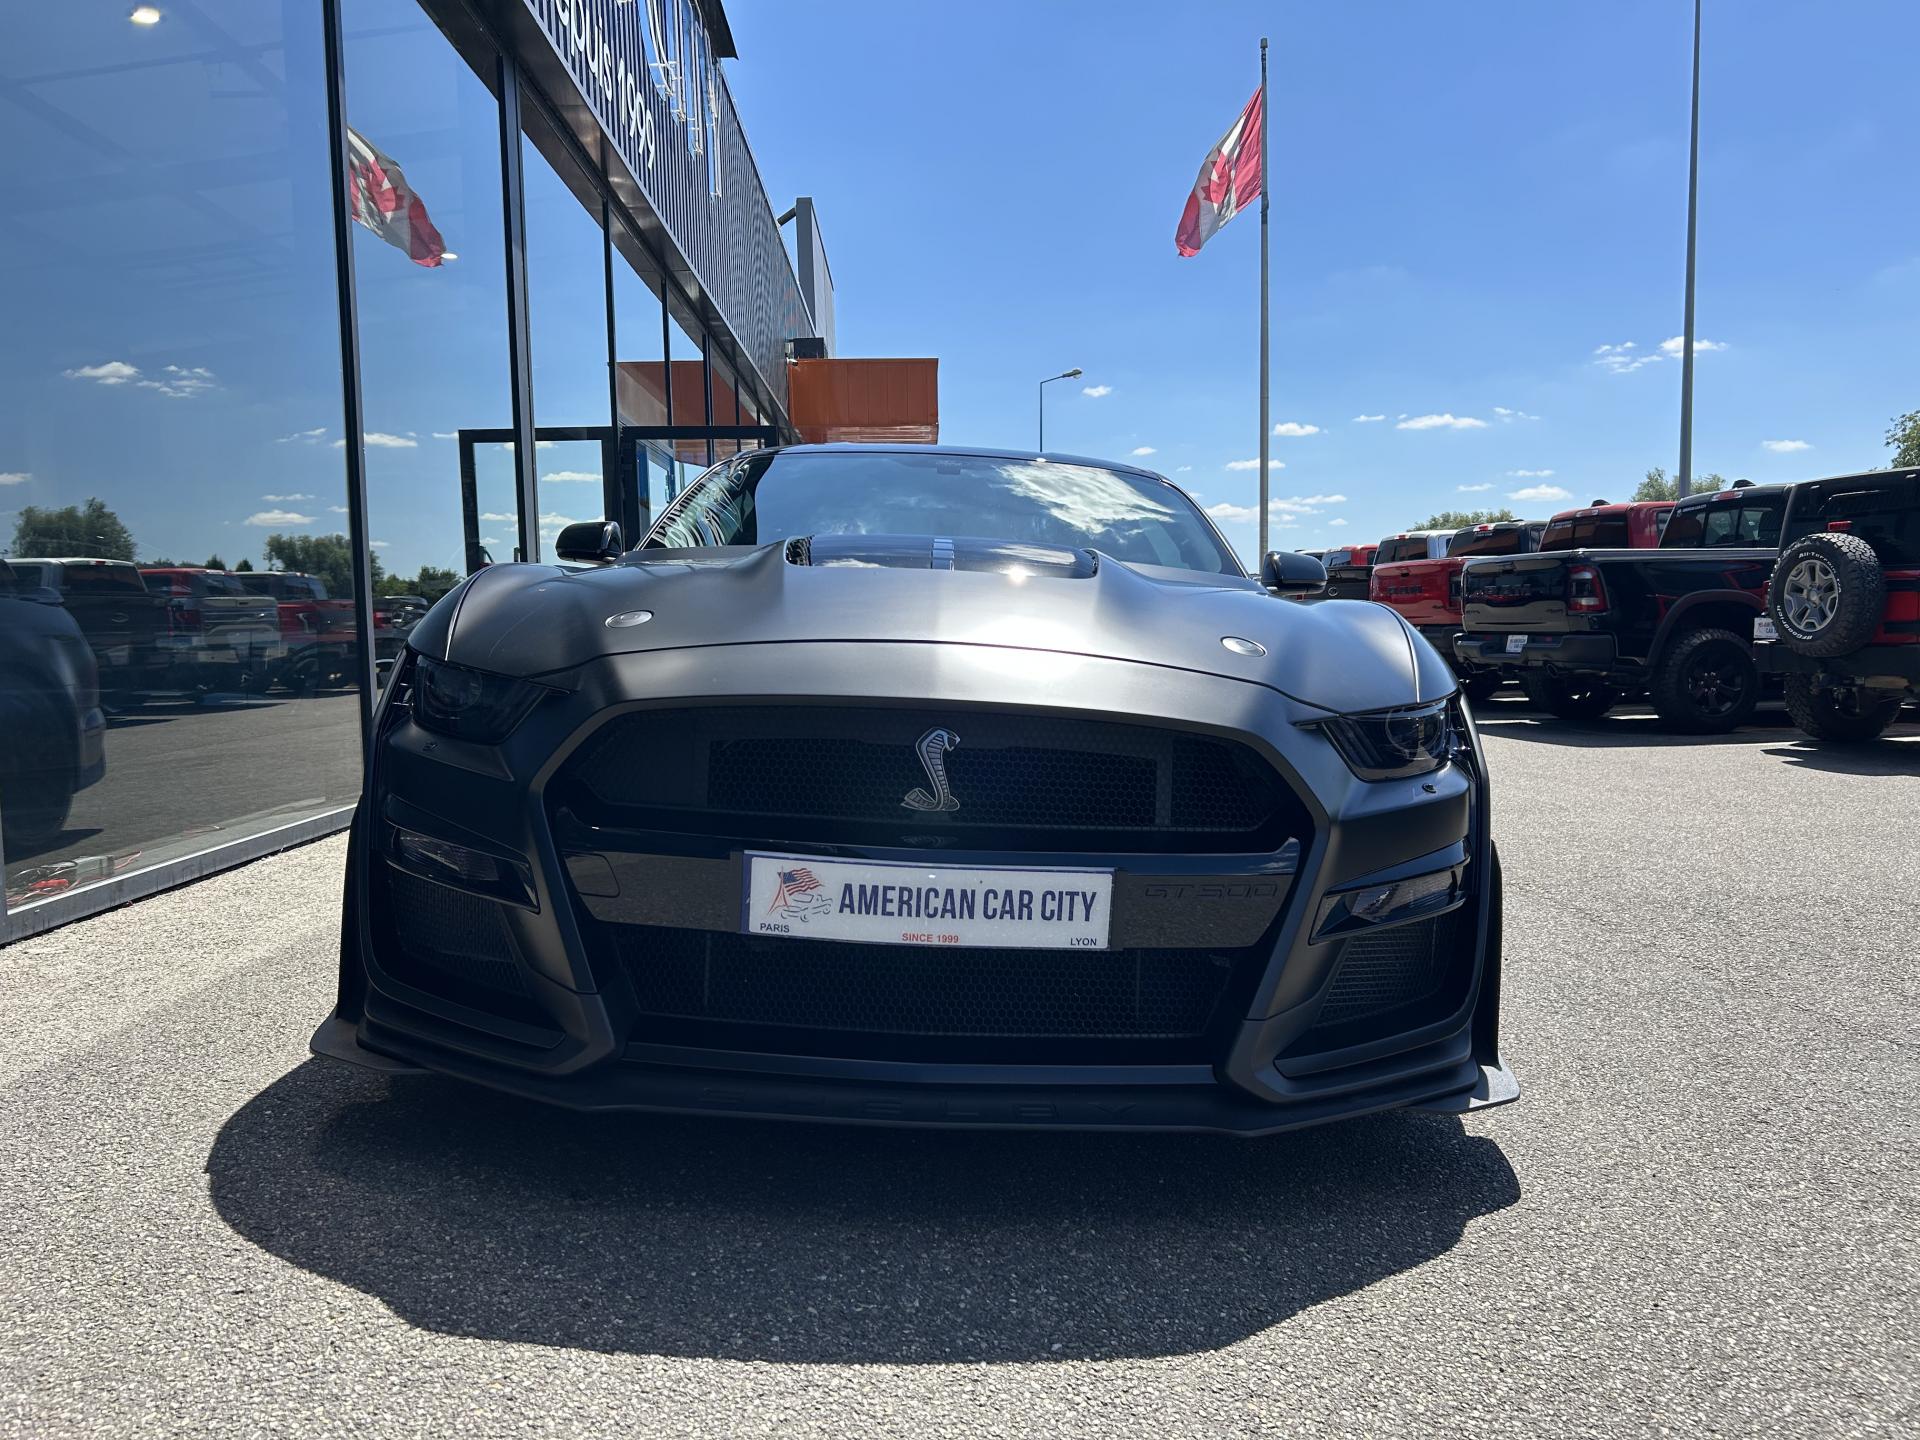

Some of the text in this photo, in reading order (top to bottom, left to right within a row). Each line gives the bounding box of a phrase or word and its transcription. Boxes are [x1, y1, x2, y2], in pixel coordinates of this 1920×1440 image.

[617, 57, 655, 171] 1999
[839, 883, 1097, 923] AMERICAN CAR CITY
[759, 922, 790, 933] PARIS
[901, 932, 959, 944] SINCE 1999
[1070, 937, 1097, 946] LYON
